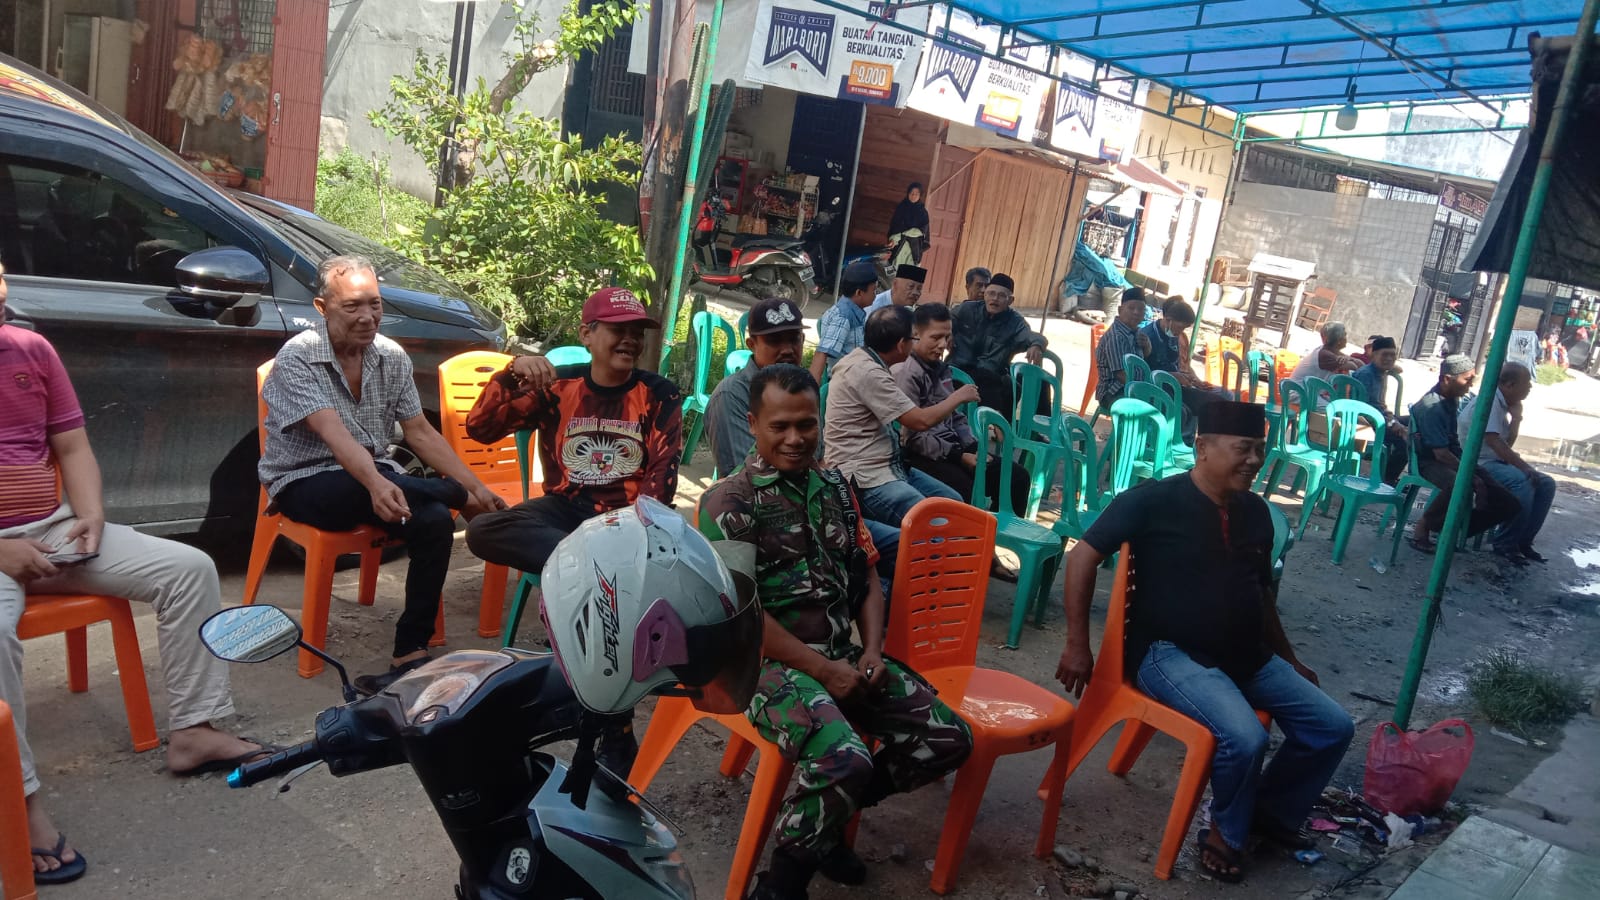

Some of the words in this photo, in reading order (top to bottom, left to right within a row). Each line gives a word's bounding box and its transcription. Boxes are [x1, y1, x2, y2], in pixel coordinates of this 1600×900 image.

[769, 24, 828, 66] MARLBORO
[842, 27, 875, 42] BUATAN
[926, 45, 977, 93] MARLBORO
[837, 483, 851, 507] Klein
[592, 557, 621, 673] Fighter
